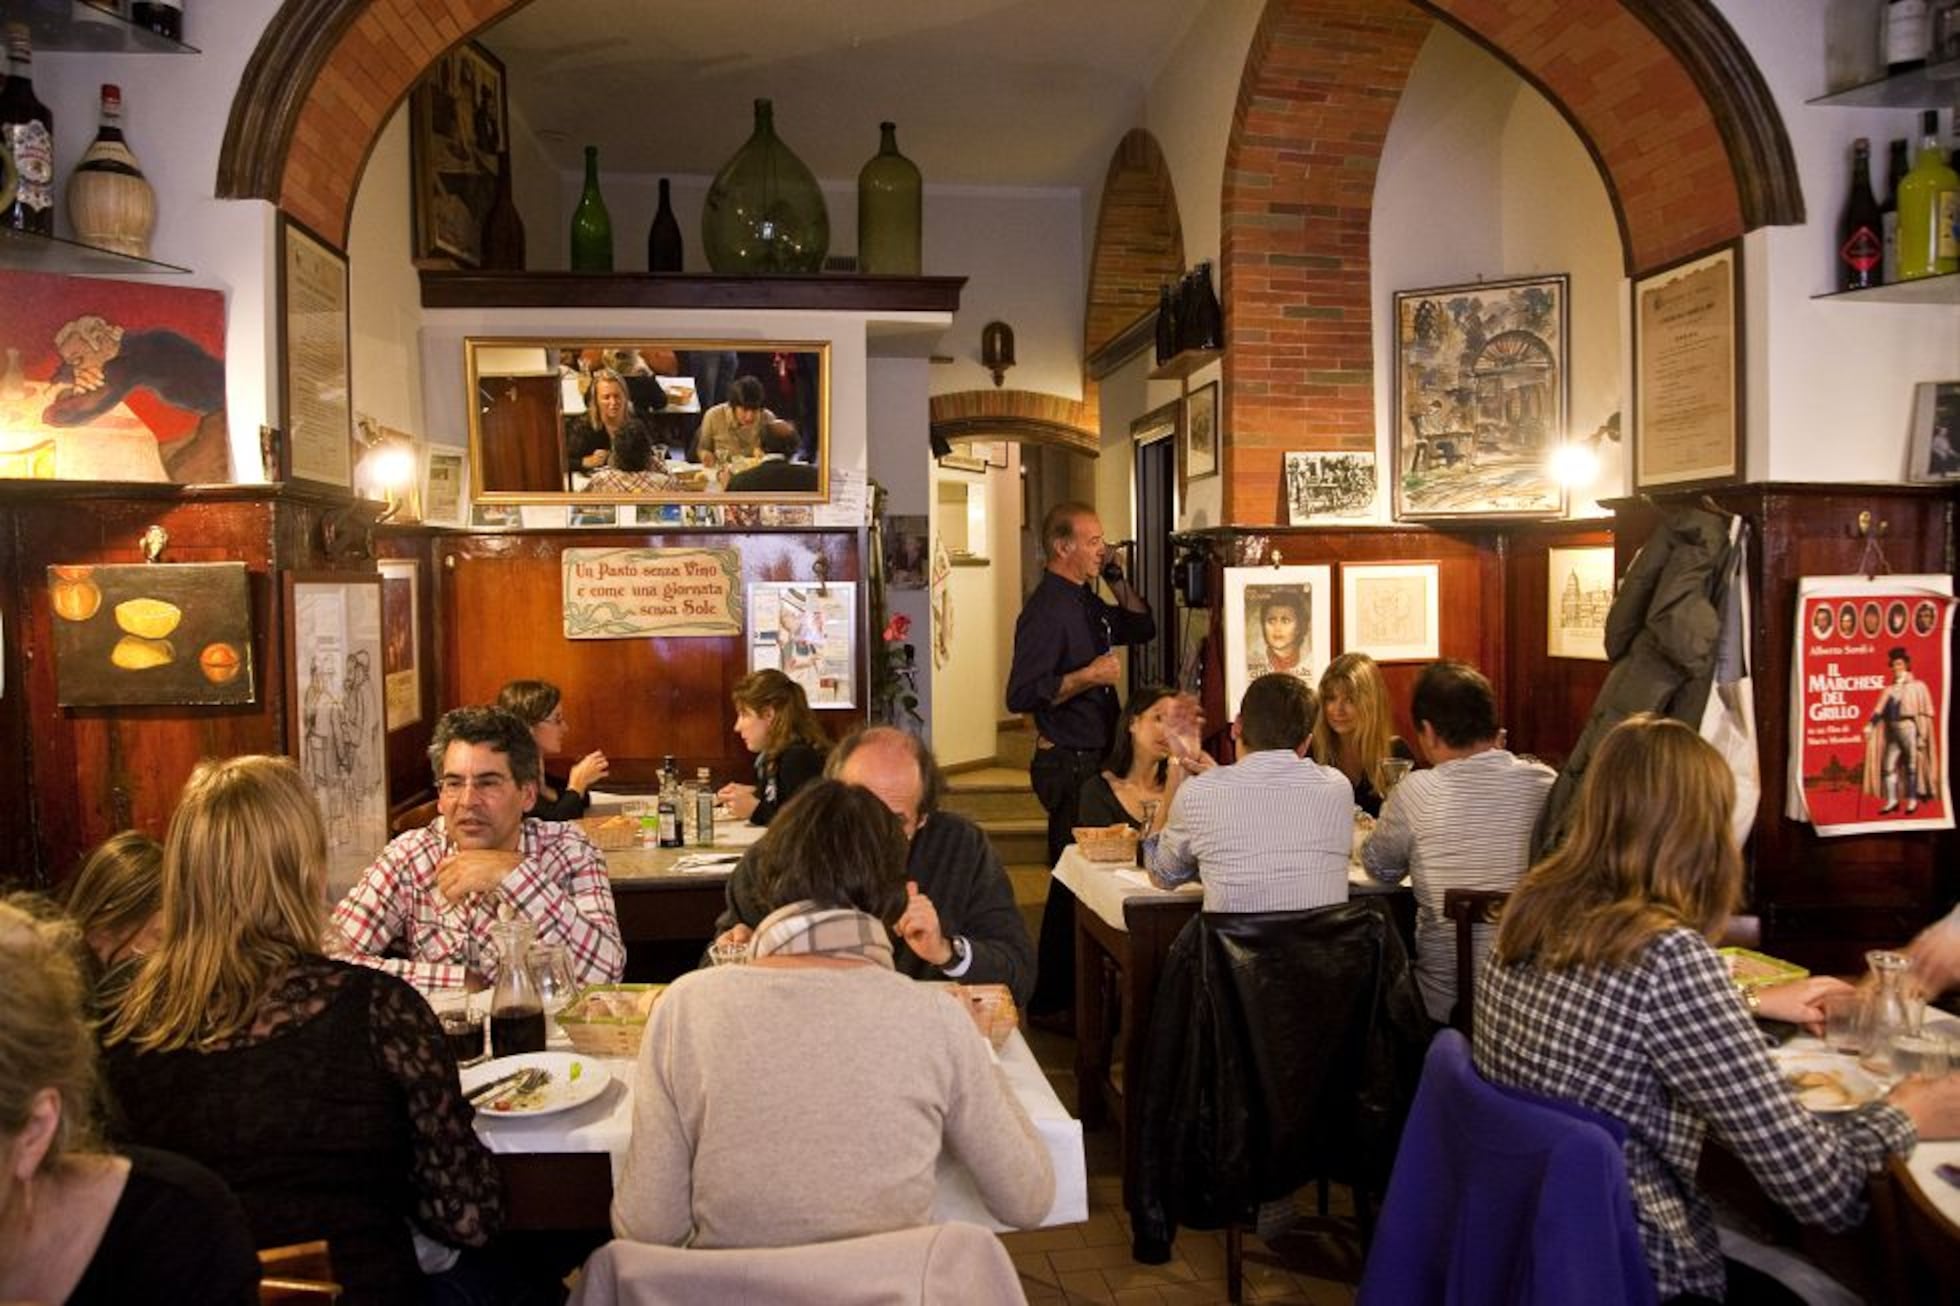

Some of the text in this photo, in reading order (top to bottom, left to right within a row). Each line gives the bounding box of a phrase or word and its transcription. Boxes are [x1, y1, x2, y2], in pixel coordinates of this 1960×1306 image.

[576, 561, 717, 580] Un Pasto senza Vino
[590, 587, 625, 597] come
[632, 585, 657, 597] una
[663, 582, 723, 600] giornata
[640, 599, 717, 616] senza Sole
[1827, 663, 1841, 676] IL
[1808, 673, 1885, 693] MARCHESE
[1822, 691, 1847, 705] DEL
[1809, 703, 1860, 721] GRILLO
